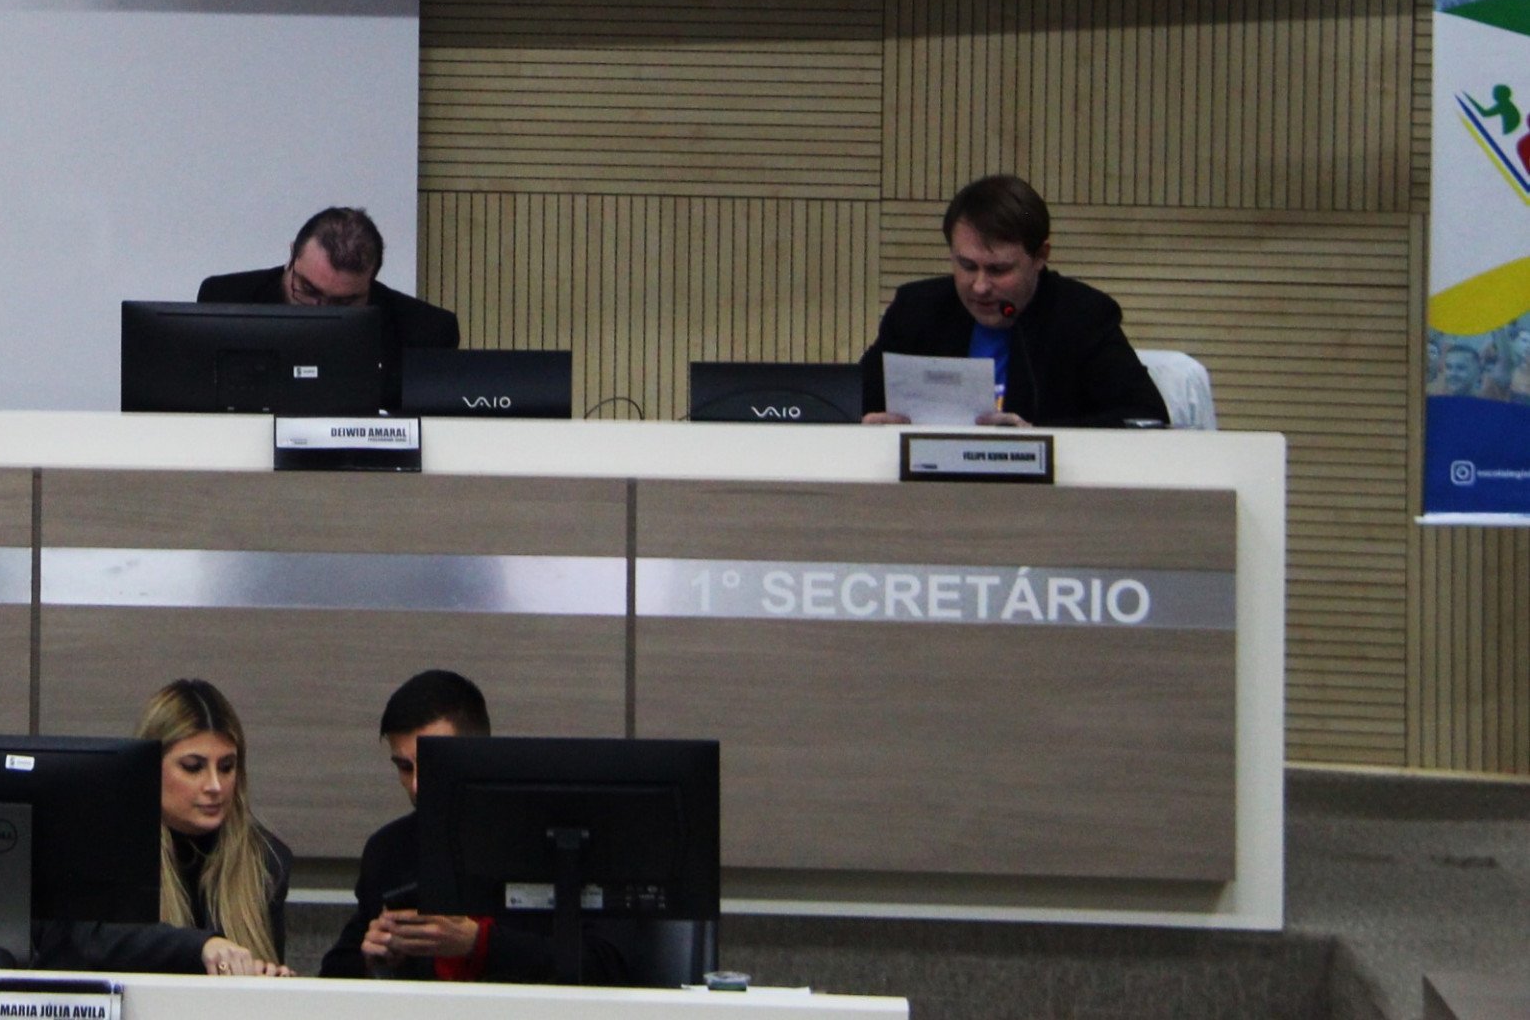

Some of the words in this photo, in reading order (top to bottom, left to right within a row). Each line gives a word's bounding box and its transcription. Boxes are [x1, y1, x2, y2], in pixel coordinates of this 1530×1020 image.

[462, 396, 512, 409] VAIO
[750, 405, 801, 419] VAIO
[330, 427, 366, 438] DEIWID
[368, 427, 407, 438] AMARAL
[690, 569, 742, 612] 1º
[761, 567, 1151, 624] SECRETÁRIO
[0, 1004, 38, 1017] MARIA
[40, 1002, 71, 1018] JÚLIA
[72, 1006, 106, 1019] AVILA
